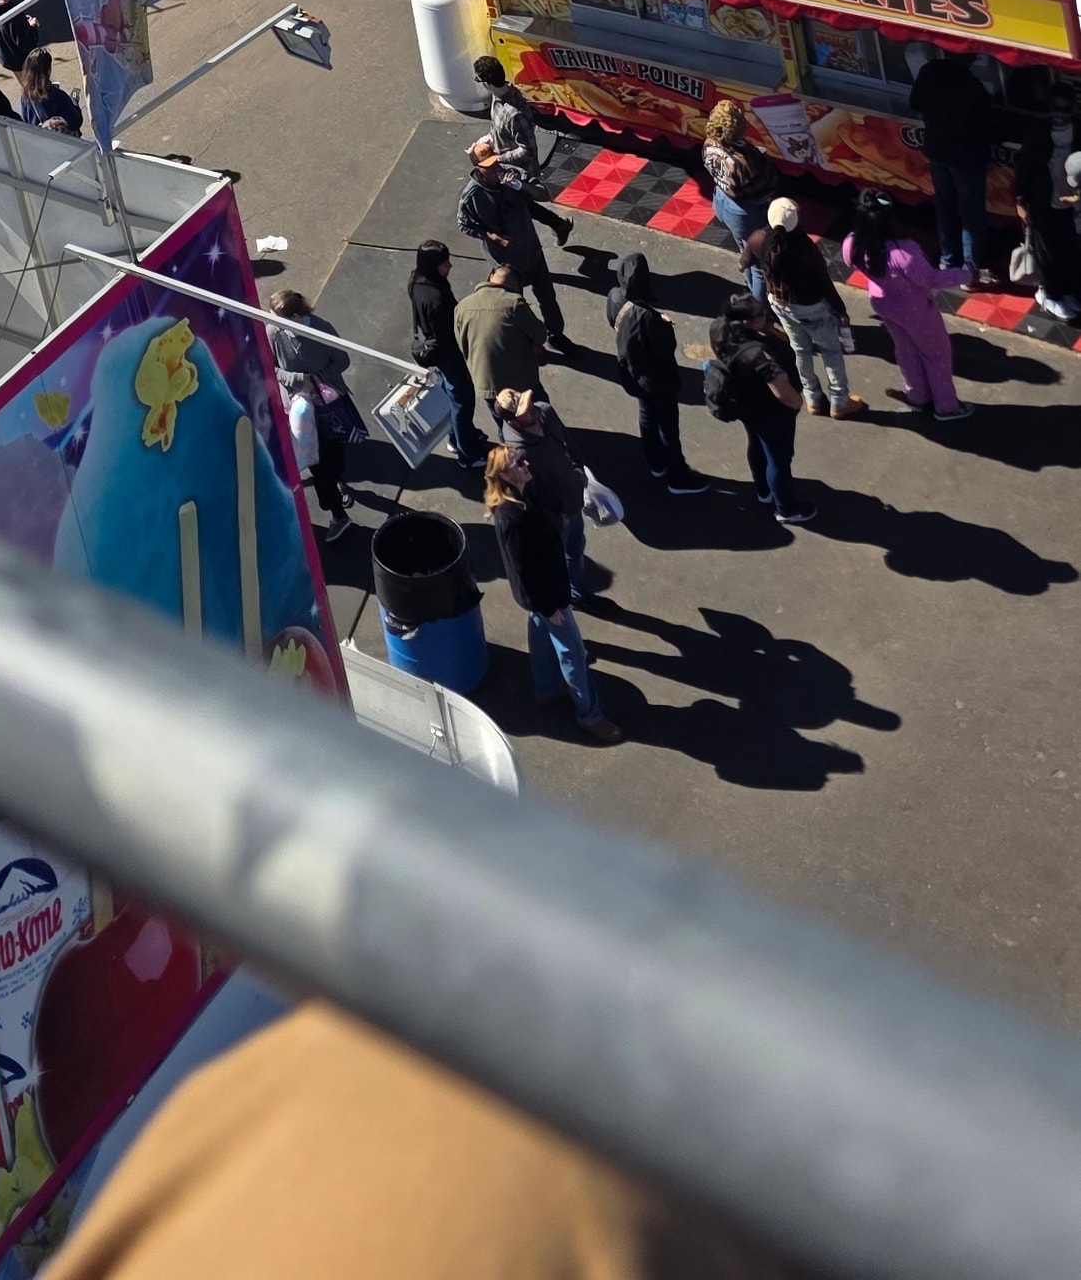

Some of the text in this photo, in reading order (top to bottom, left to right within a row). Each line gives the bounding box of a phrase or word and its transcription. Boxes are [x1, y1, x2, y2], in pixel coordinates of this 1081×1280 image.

[550, 46, 705, 101] ITALIAN & POLISH
